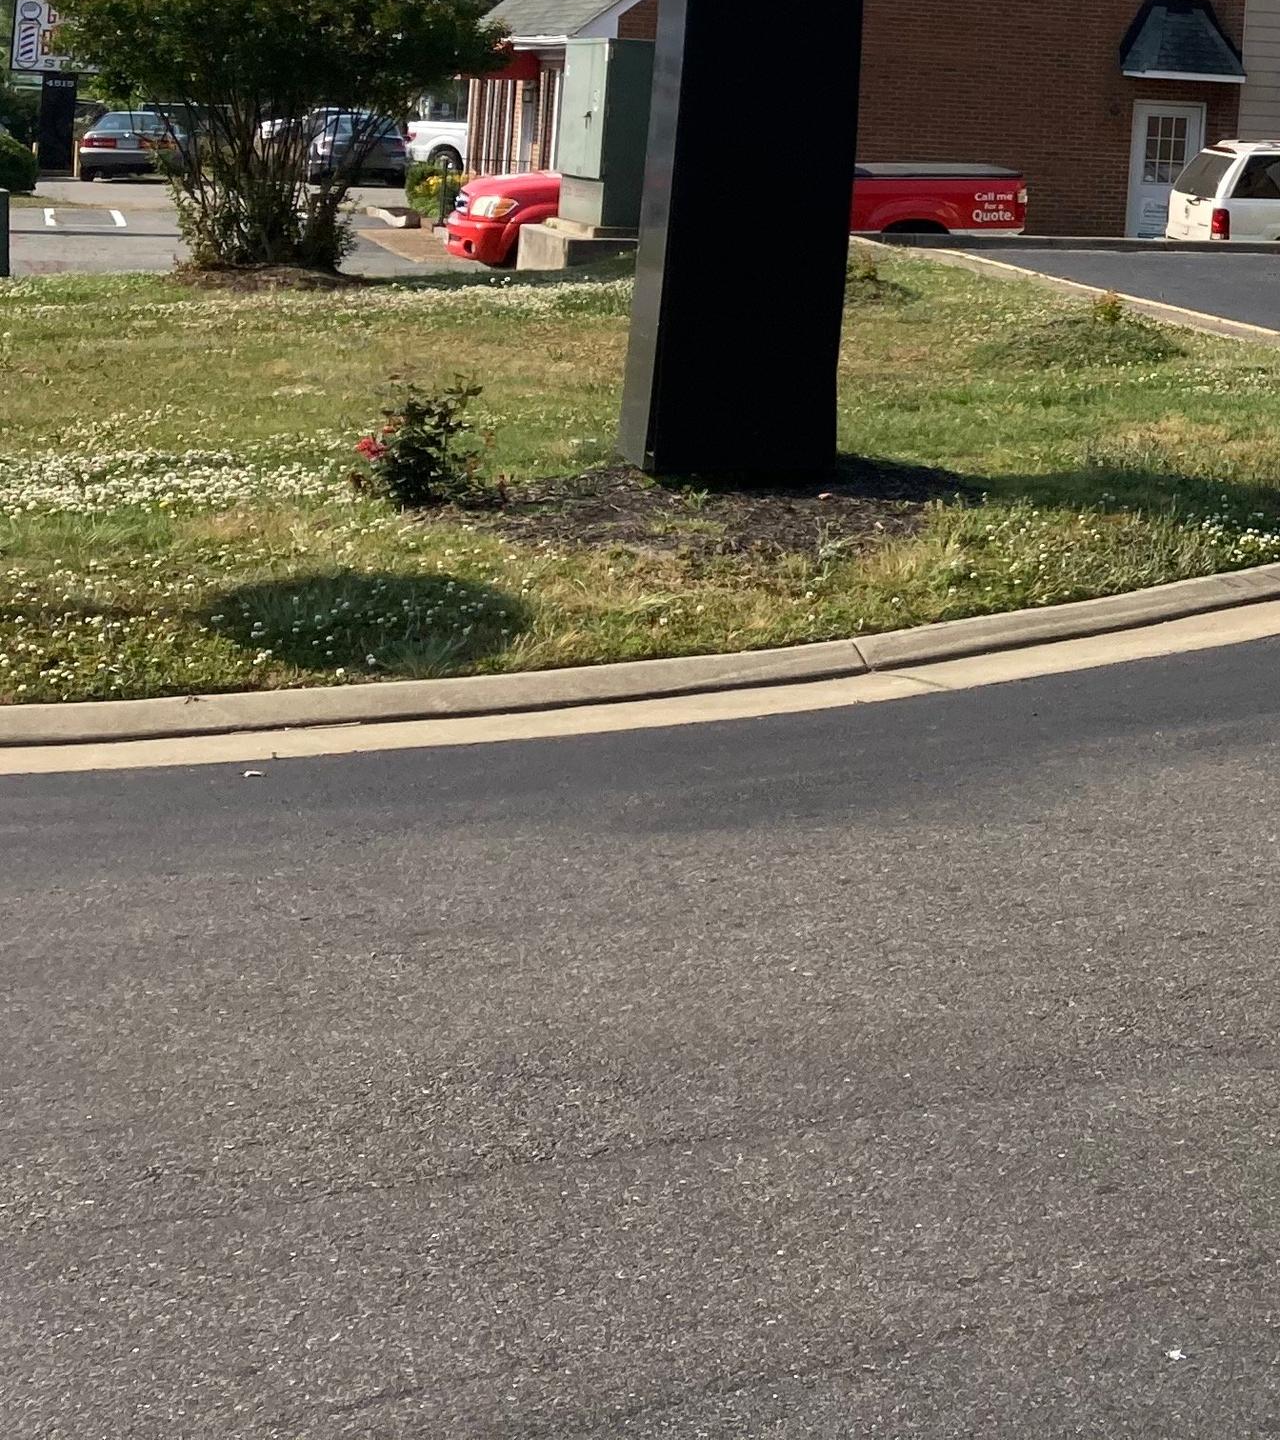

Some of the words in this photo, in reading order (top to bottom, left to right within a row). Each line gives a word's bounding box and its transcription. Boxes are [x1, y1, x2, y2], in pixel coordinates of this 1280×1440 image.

[974, 192, 995, 201] Call
[996, 193, 1013, 201] me
[984, 202, 997, 210] for
[972, 209, 1015, 223] Quote.
